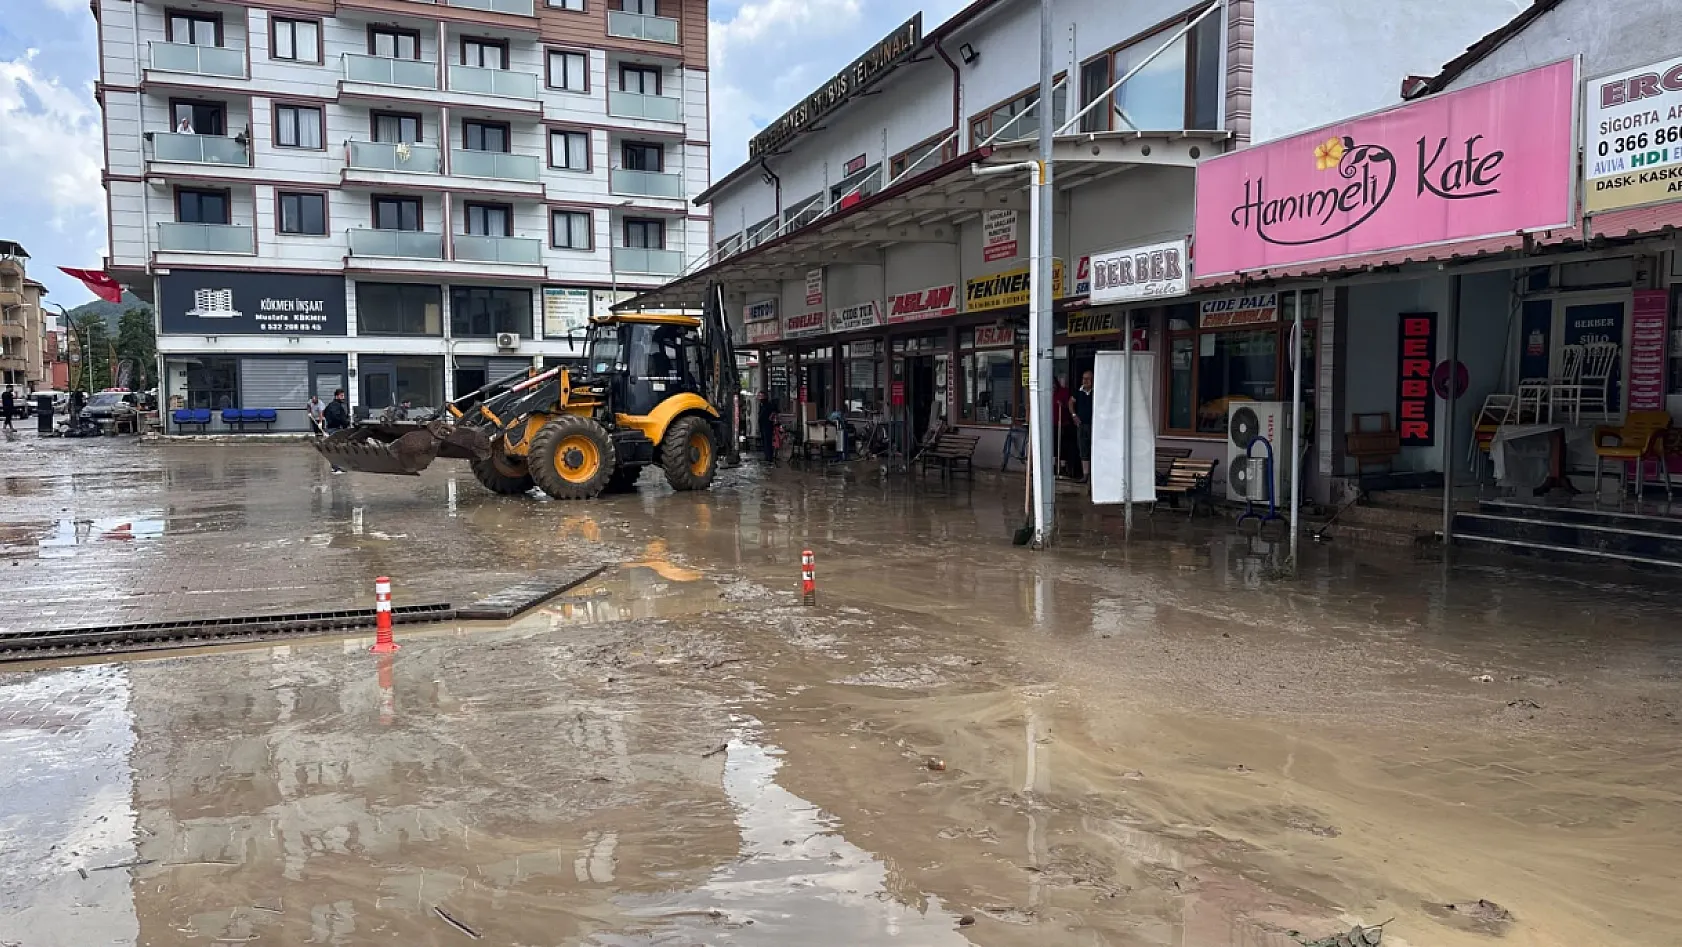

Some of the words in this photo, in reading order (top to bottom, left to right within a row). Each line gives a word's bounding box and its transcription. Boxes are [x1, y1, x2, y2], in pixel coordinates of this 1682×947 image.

[1600, 110, 1659, 135] SİGORTA
[1598, 141, 1608, 157] 0
[1614, 133, 1648, 154] 366
[1594, 157, 1625, 175] AVIVA
[1631, 149, 1668, 167] HDI
[1673, 147, 1682, 160] E
[1232, 155, 1390, 242] Hanımeli
[1417, 134, 1504, 199] Kafe
[1596, 176, 1635, 191] DASK-
[1094, 248, 1182, 290] BERBER
[260, 298, 294, 312] KÖKMEN
[295, 298, 324, 314] İNŞAAT
[889, 286, 954, 315] ASLAN
[1239, 294, 1276, 309] PALA
[1574, 318, 1614, 328] BERBER
[976, 327, 1012, 345] ASLAN
[1401, 318, 1431, 438] BERBER
